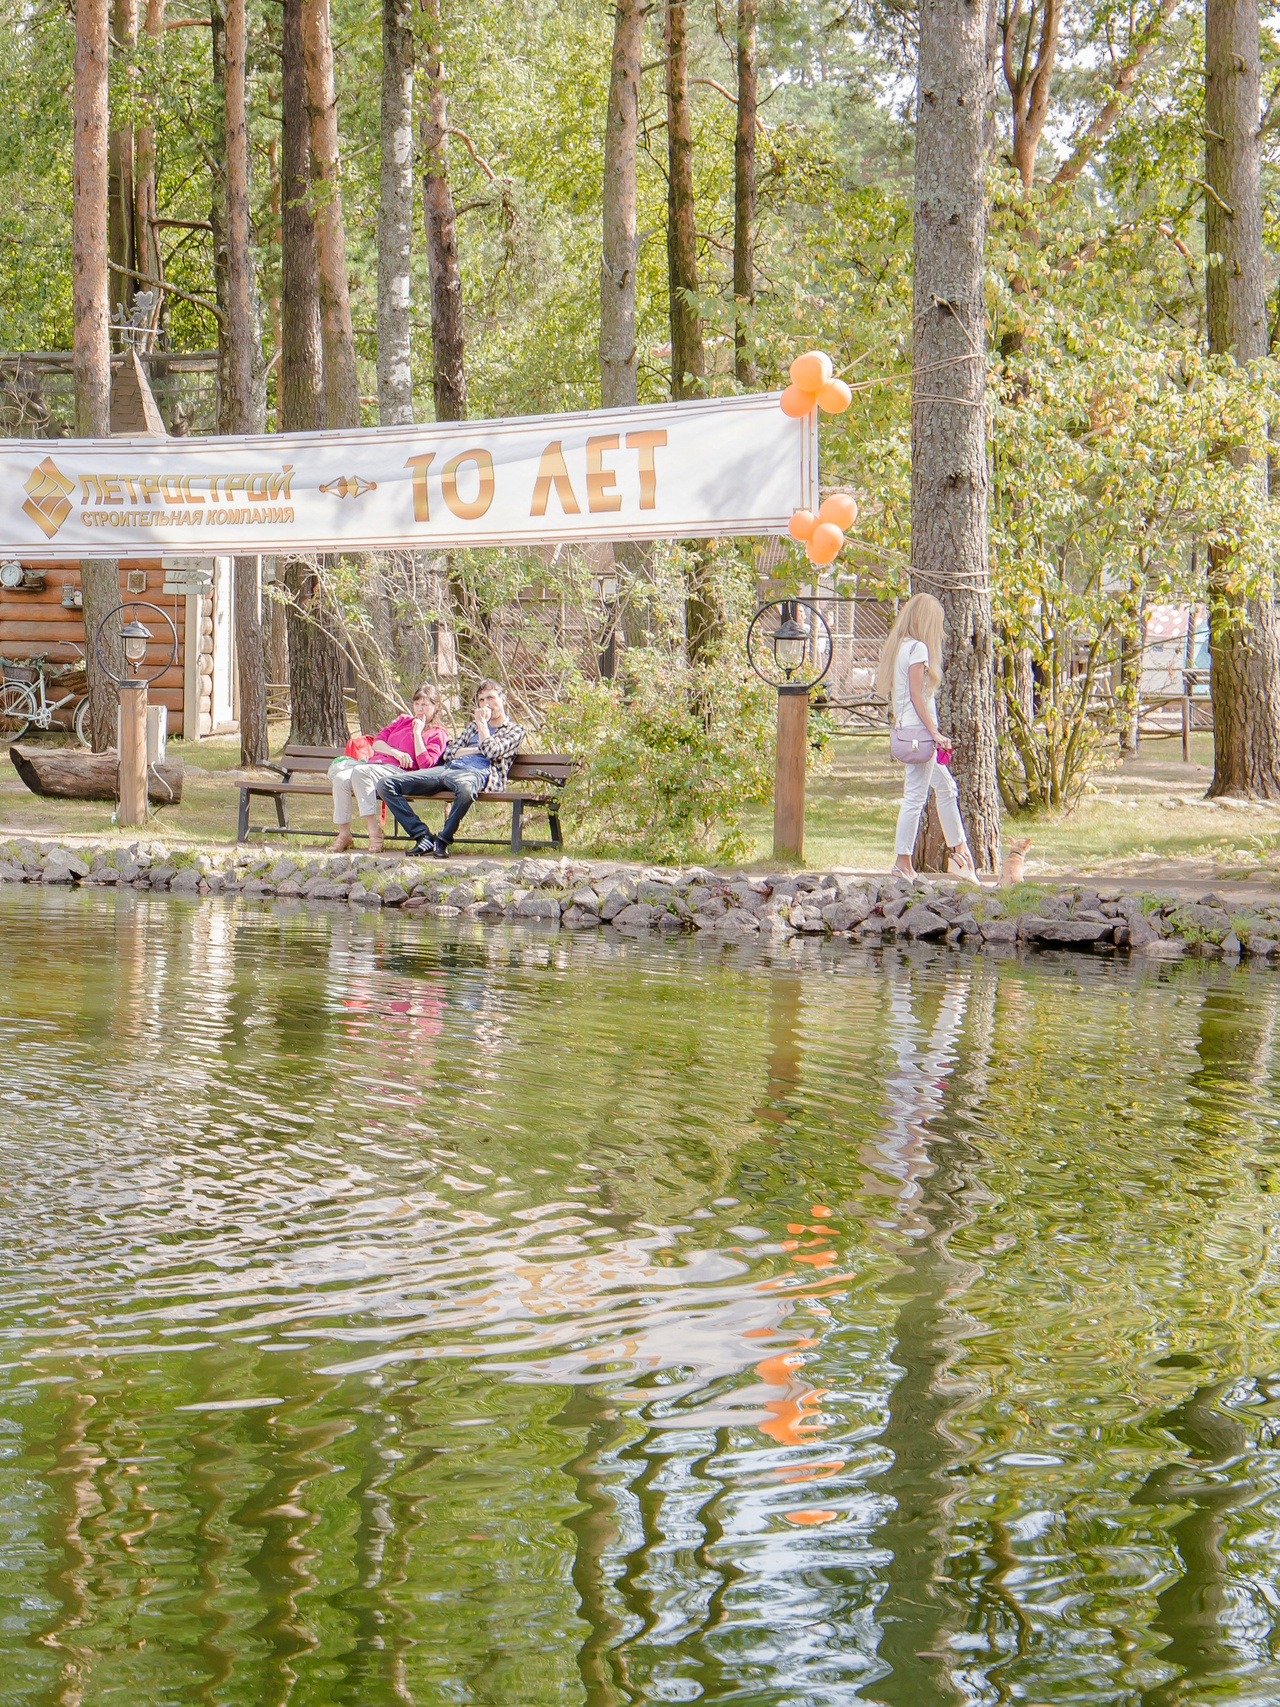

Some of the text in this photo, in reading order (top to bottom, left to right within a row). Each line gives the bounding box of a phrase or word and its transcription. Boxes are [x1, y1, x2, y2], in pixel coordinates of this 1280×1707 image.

[78, 465, 296, 505] ПЕТРОСТРОЙ
[403, 429, 668, 522] 10 ЛЕТ
[81, 507, 295, 527] СТРОИТЕЛЬНАЯ КОМПАНИЯ
